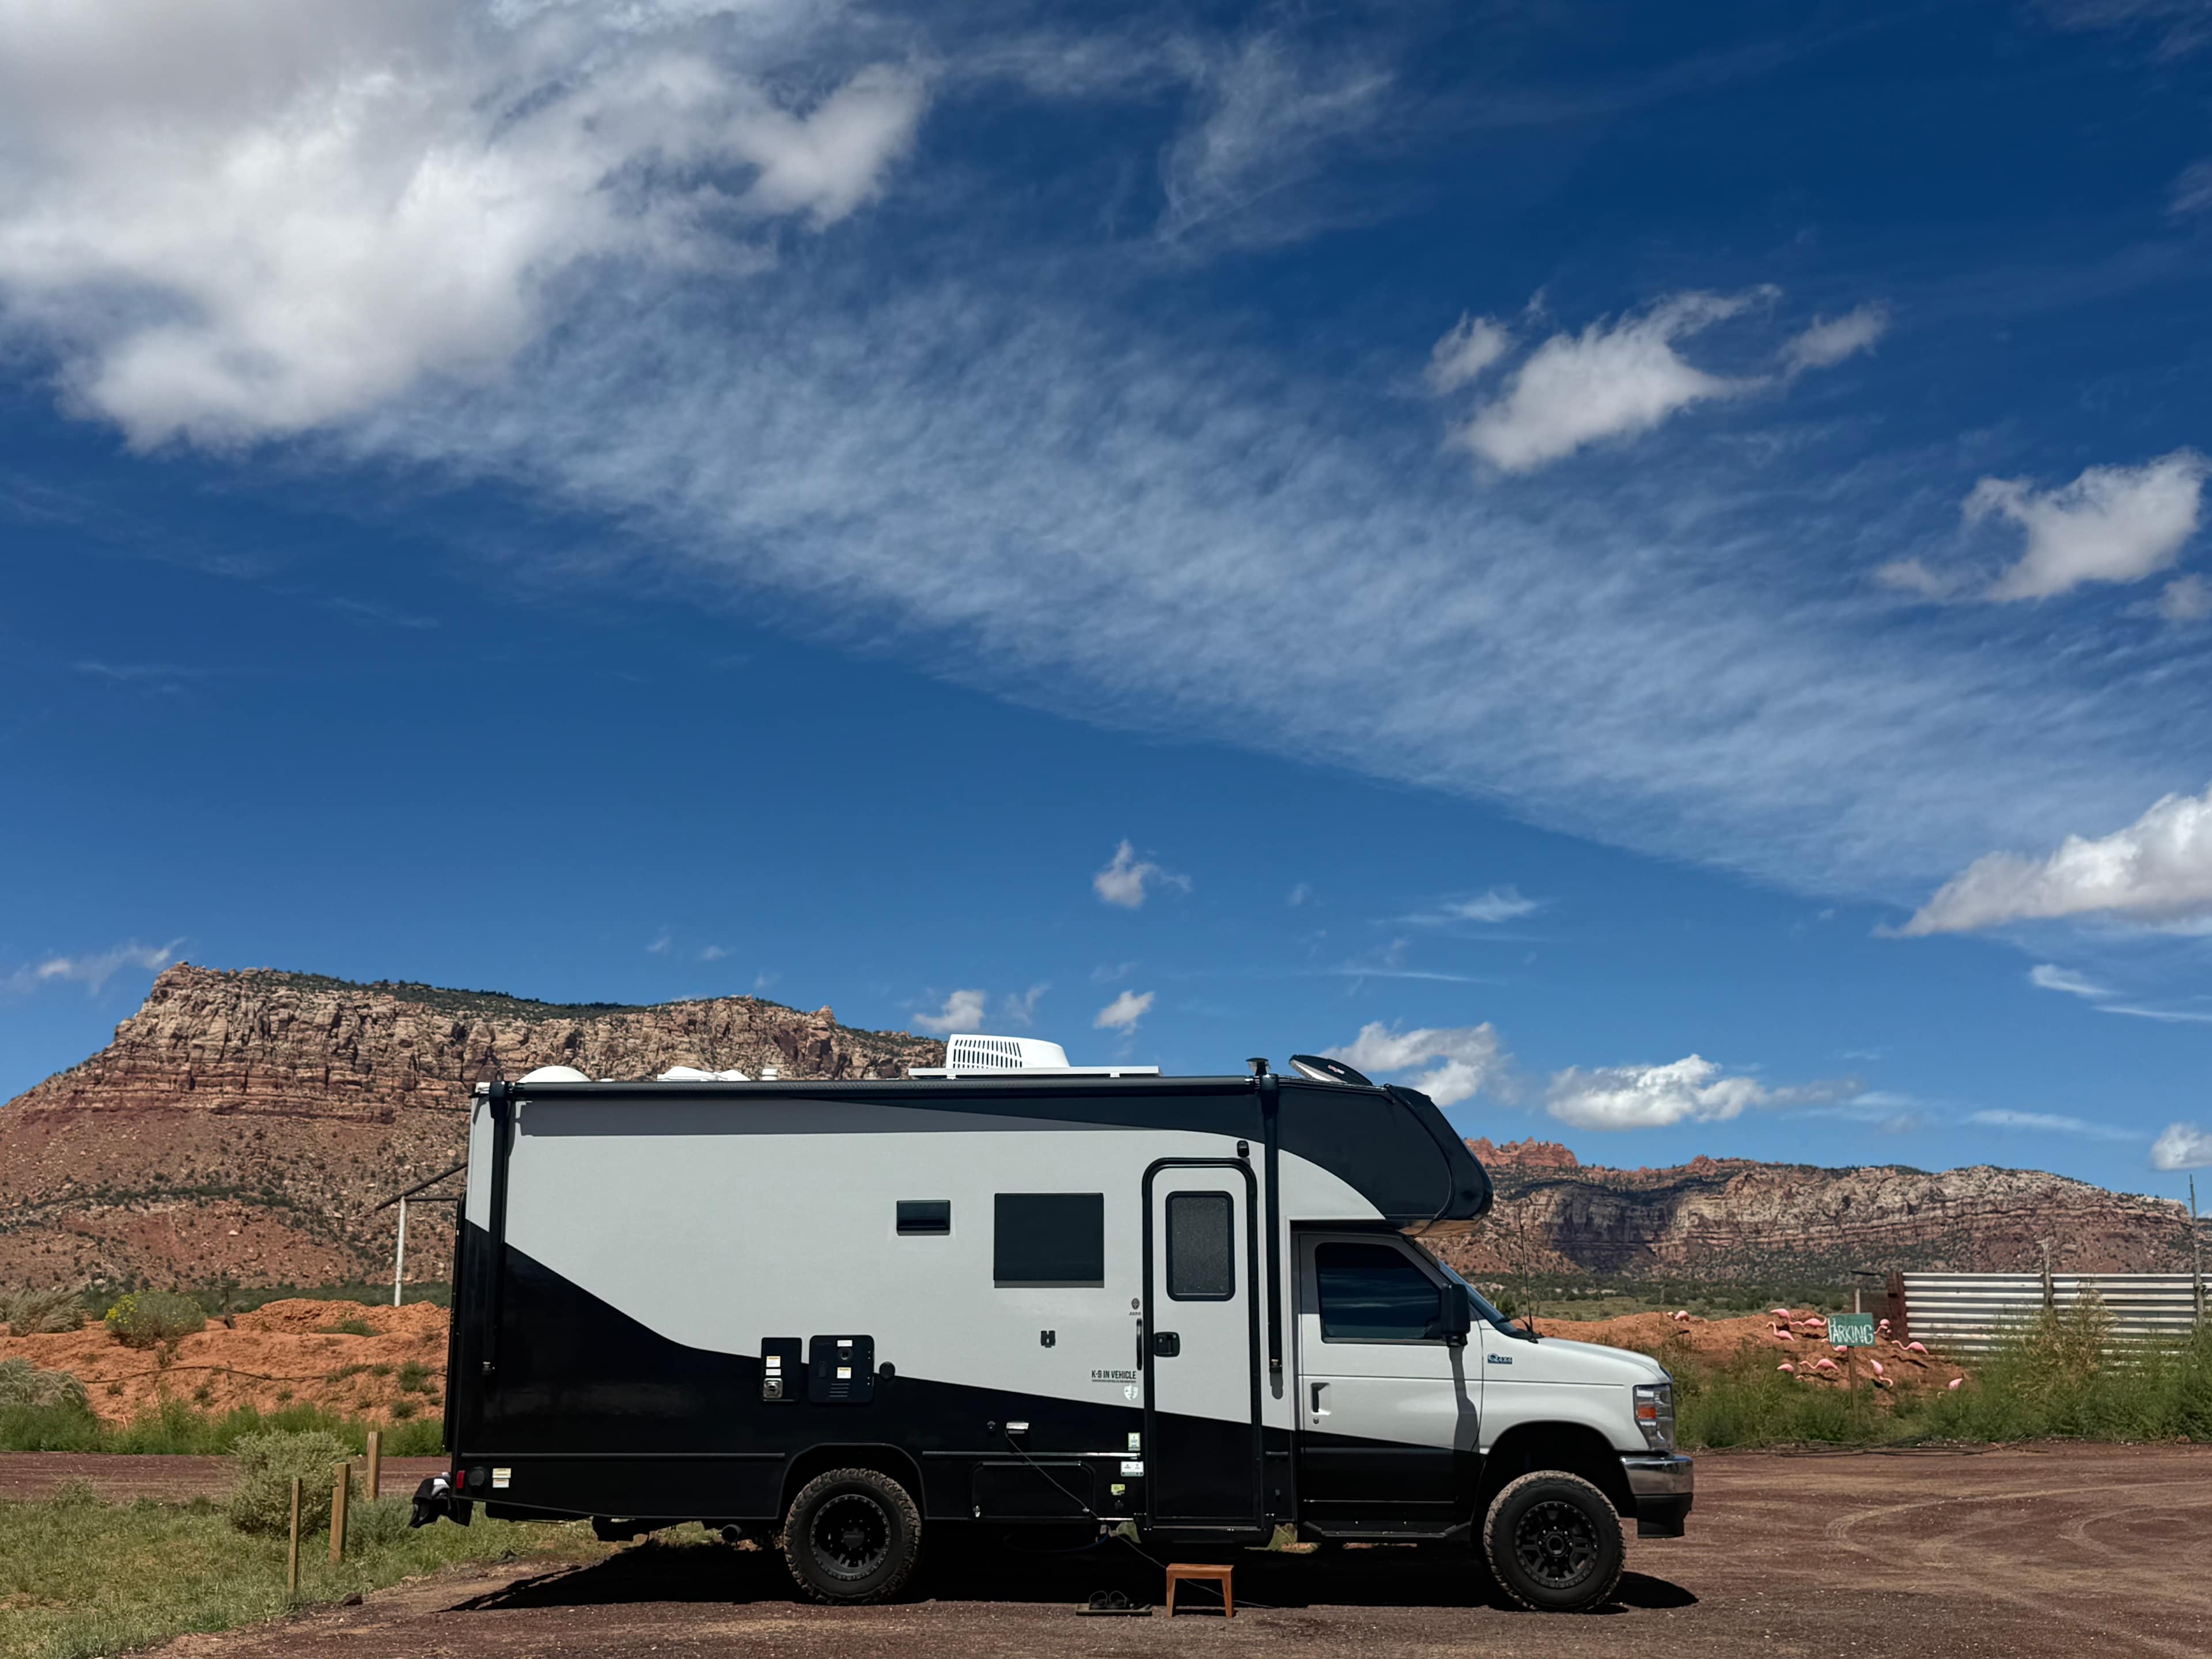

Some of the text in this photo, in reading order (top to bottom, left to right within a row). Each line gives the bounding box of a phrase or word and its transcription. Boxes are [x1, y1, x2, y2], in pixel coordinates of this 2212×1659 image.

[1827, 1317, 1873, 1344] PARKING
[1092, 1370, 1137, 1379] K-9 IN VEHICLE
